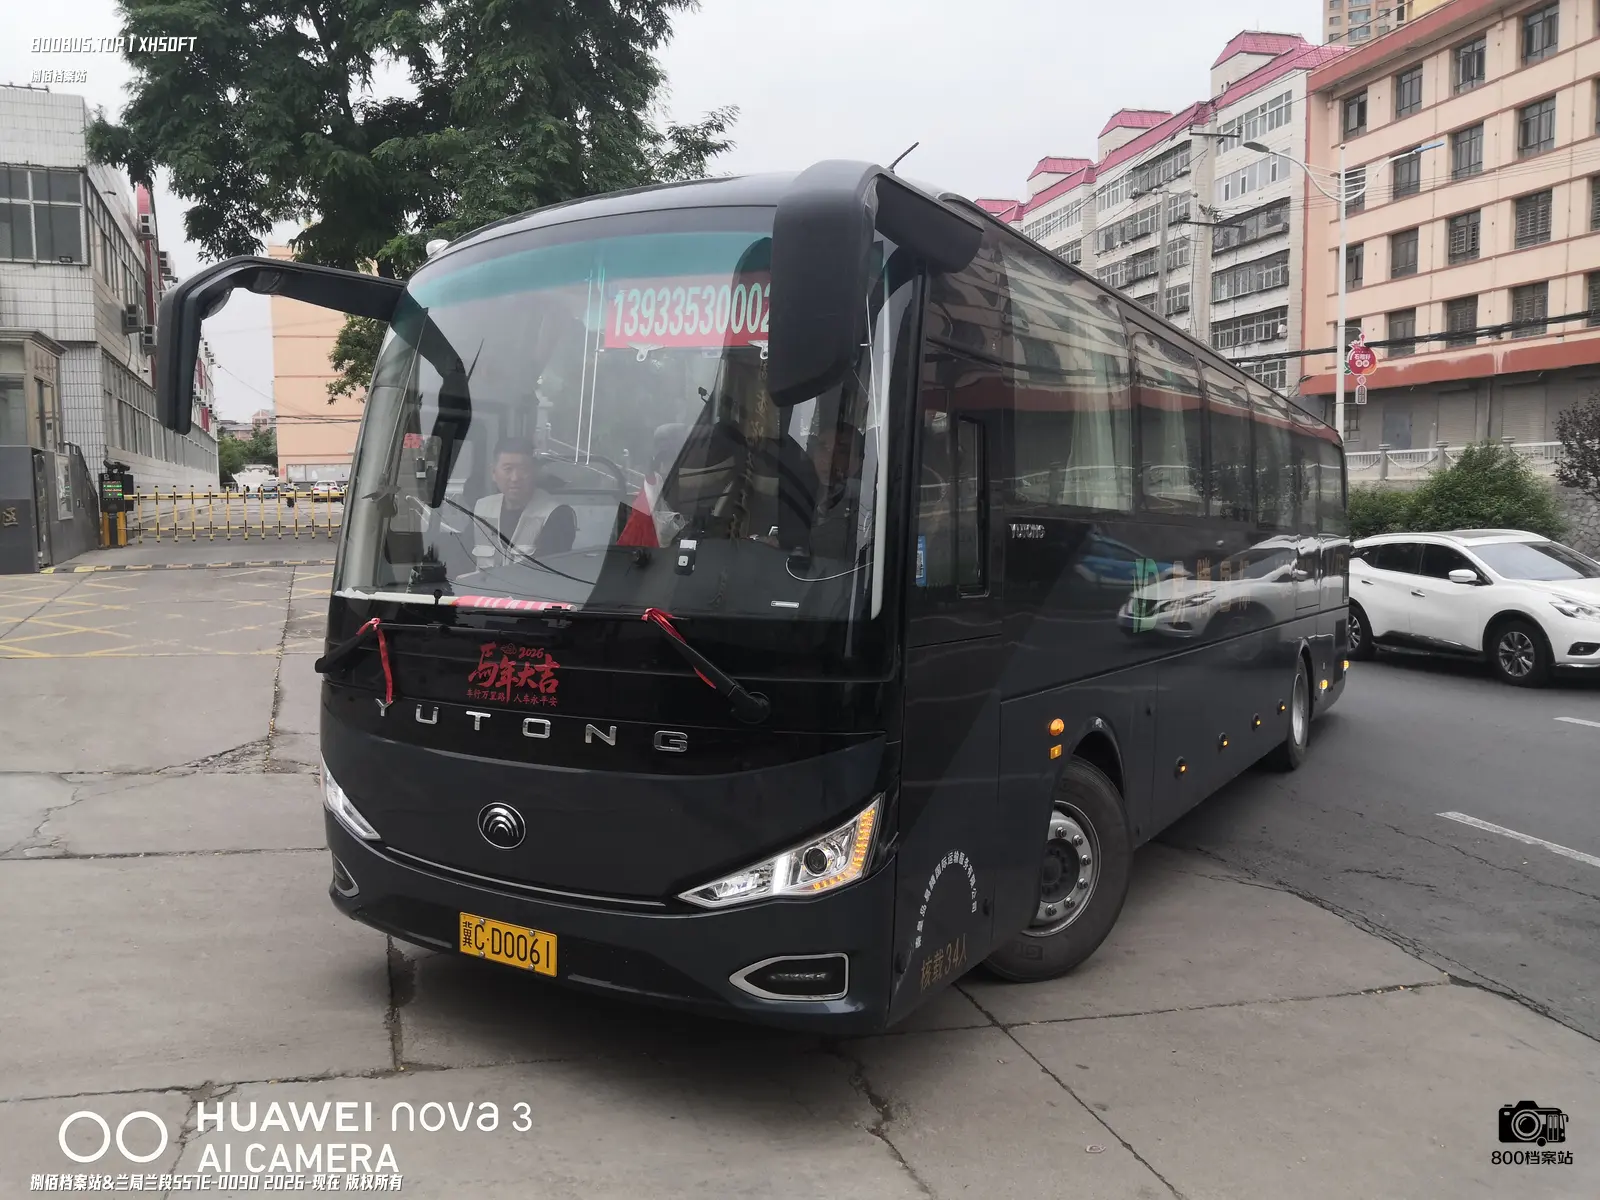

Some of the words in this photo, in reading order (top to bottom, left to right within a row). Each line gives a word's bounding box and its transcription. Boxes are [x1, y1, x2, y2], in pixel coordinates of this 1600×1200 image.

[613, 282, 770, 338] 13933530002
[467, 641, 561, 703] 马年大吉
[518, 646, 545, 659] 2026
[466, 688, 506, 702] 车行万里路
[513, 693, 558, 707] 人车永平安
[375, 698, 689, 753] YUTONG
